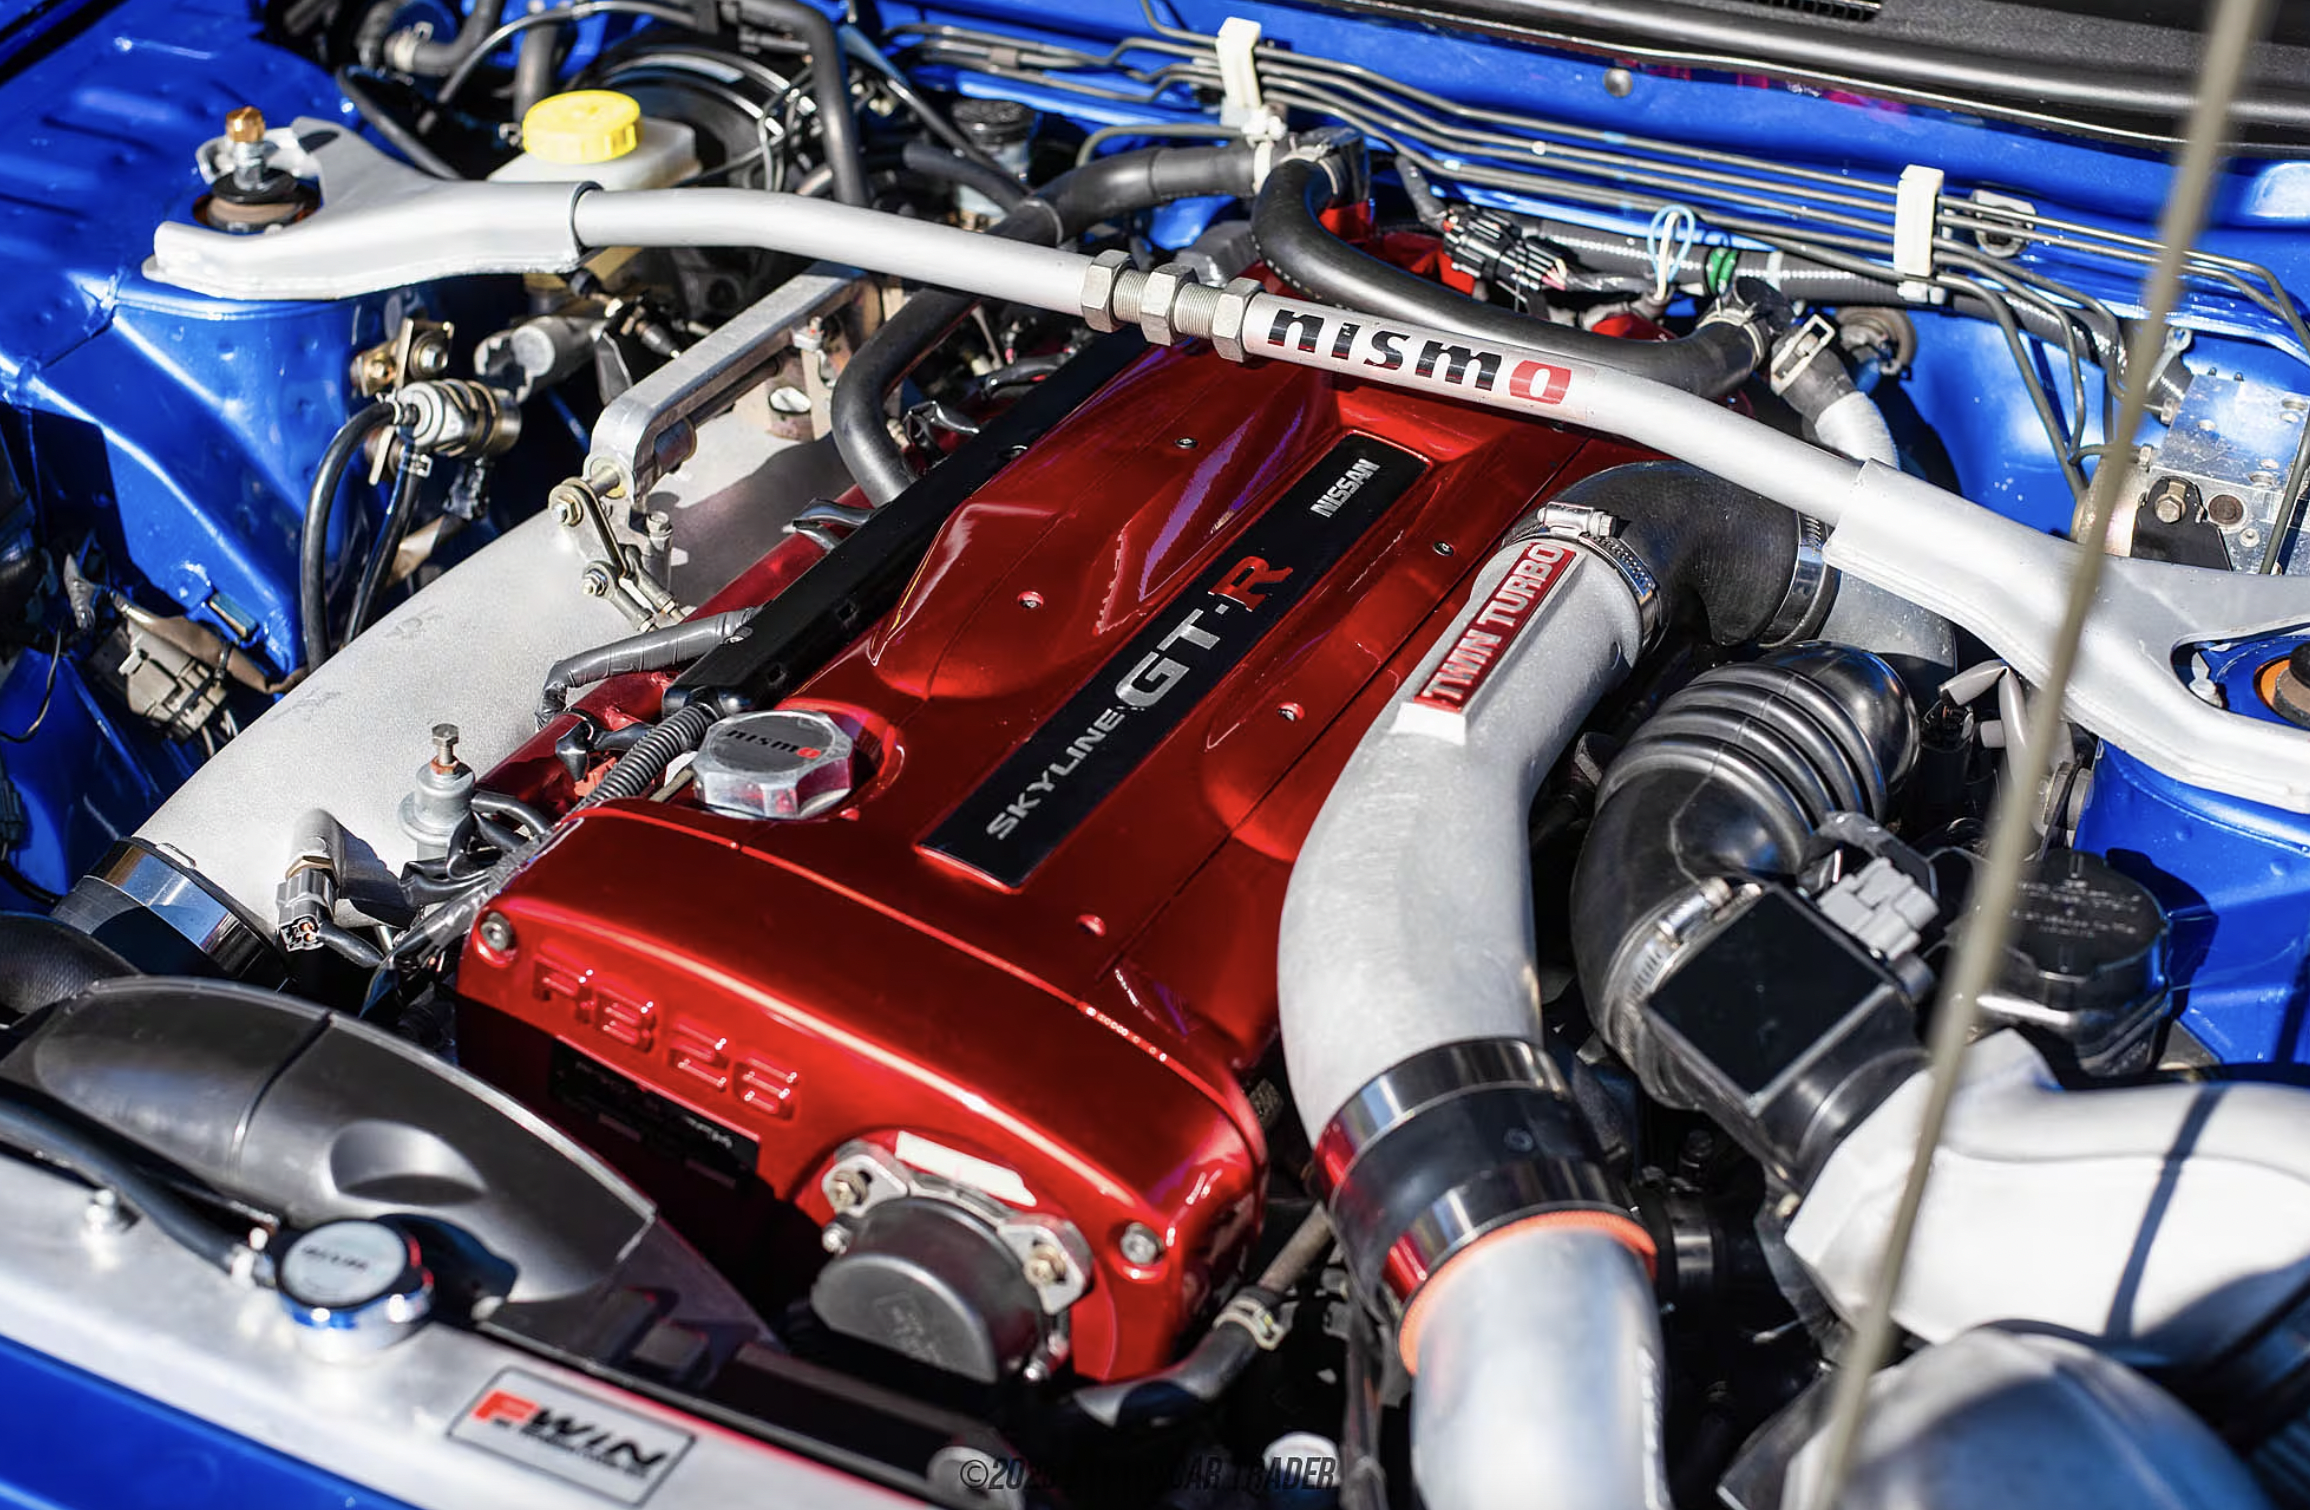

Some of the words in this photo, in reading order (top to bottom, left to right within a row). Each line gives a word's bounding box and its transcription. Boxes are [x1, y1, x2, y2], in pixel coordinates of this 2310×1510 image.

[1267, 308, 1572, 404] nismo
[1310, 457, 1380, 518] NISSAN
[1421, 628, 1501, 700] TWIN
[1477, 543, 1566, 627] TURBO
[986, 706, 1126, 840] SKYLINE
[531, 943, 799, 1121] RB26
